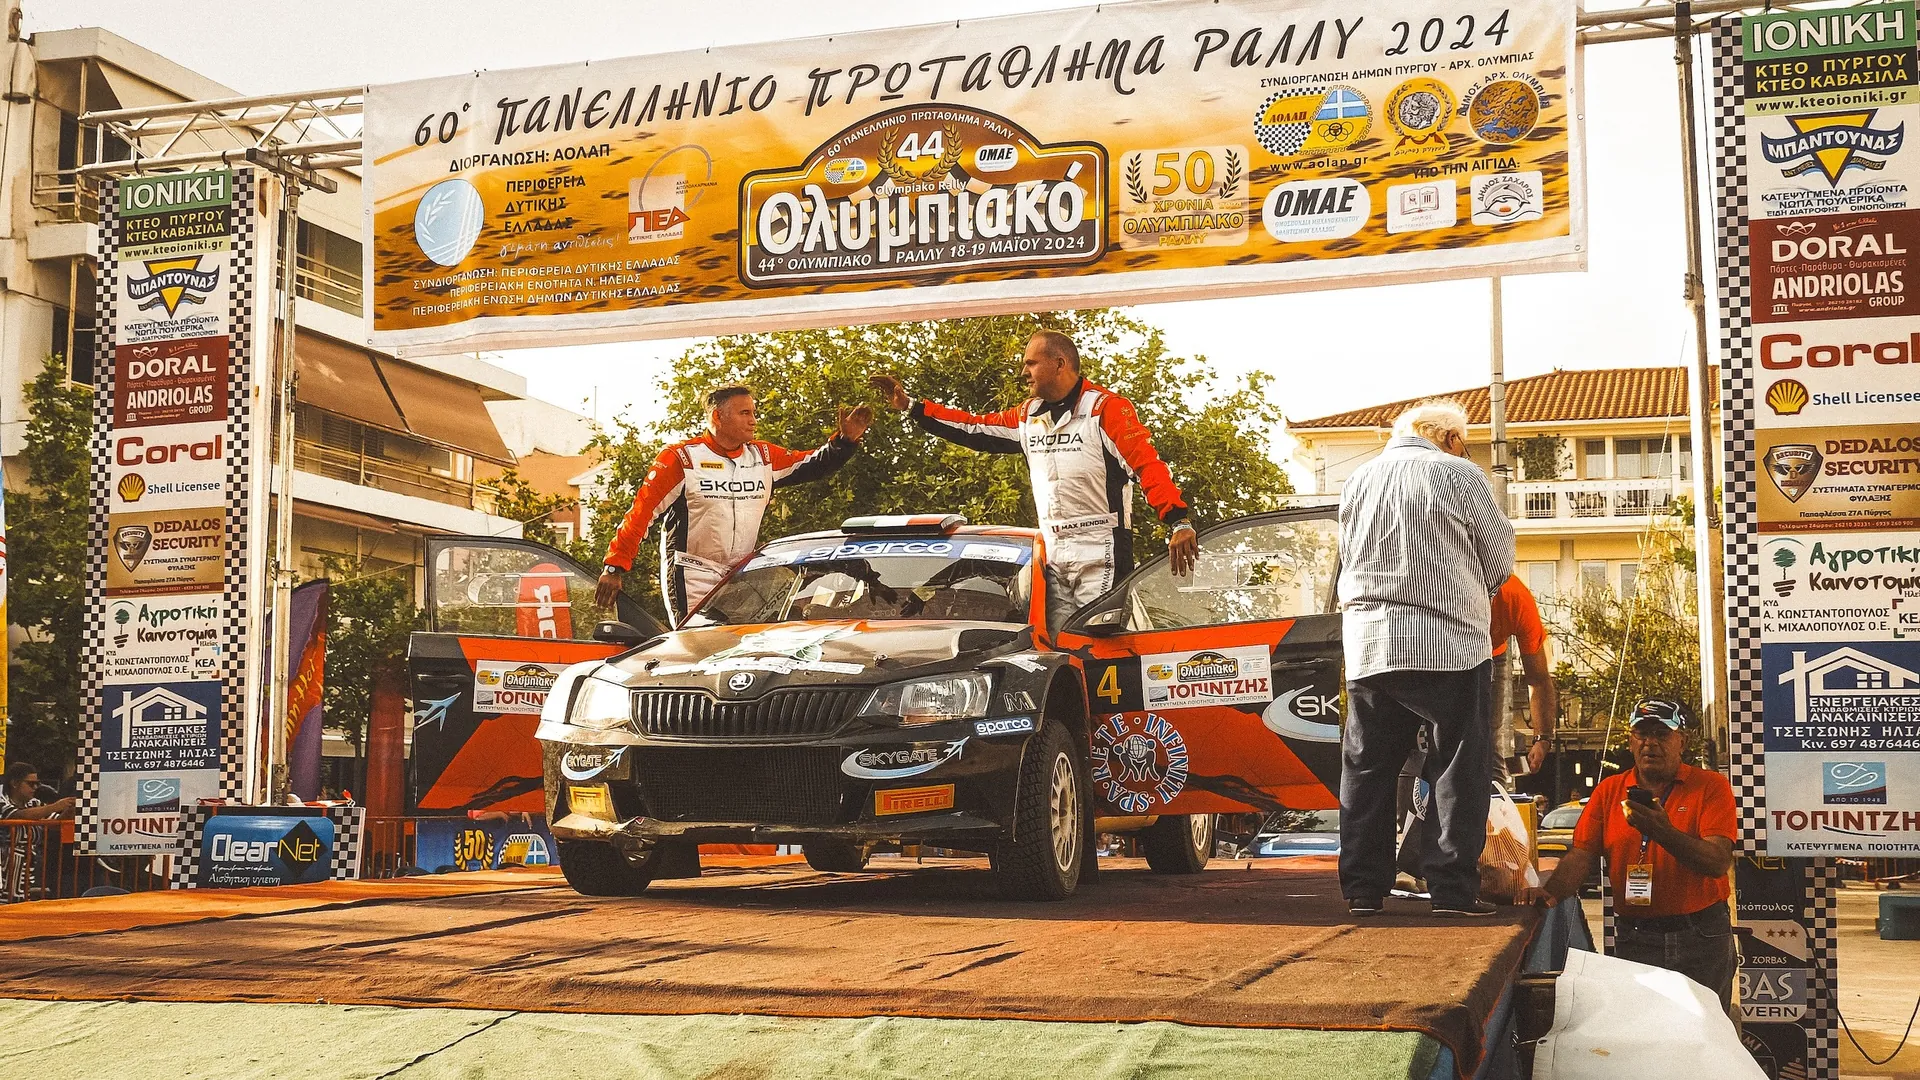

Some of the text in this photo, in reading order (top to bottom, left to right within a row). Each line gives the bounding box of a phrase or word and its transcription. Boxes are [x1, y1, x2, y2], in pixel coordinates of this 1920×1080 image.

[1384, 7, 1514, 55] 2024
[1752, 9, 1905, 52] ΙΟΝΙΚΗ
[1260, 51, 1535, 88] ΣΥΝΔΙΟΡΓΑΝΩΣΗ ΔΗΜΩΝ ΠΥΡΓΟΥ ΑΡΧ. ΟΛΥΜΠΙΑΣ
[1756, 53, 1907, 78] ΚΤΕΟ ΠΥΡΓΟΥ
[1757, 69, 1908, 93] ΚΤΕΟ ΚΑΒΑΣΙΛΑ
[1756, 90, 1907, 112] www.kteoioniki.gr
[843, 114, 907, 146] ΠΑΝΕΛΛΗΝΙΟ
[911, 111, 980, 126] ΠΡΩΤΑΘΛΗΜΑ
[983, 120, 1015, 139] ΡΑΛΛΥ
[896, 130, 944, 162] 44
[1767, 130, 1900, 159] ΜΠΑΝΤΟΥΝΑΣ
[449, 143, 611, 173] ΔΙΟΡΓΑΝΩΣΗ: ΑΟΛΑΠ
[979, 148, 1014, 161] ΟΜΑΕ
[1152, 150, 1215, 196] 50
[1413, 157, 1520, 179] ΥΠΟ ΤΗΝ ΑΙΓΙΔΑ:
[125, 175, 225, 210] ΙΟΝΙΚΗ
[506, 175, 586, 193] ΠΕΡΙΦΕΡΕΙΑ
[876, 178, 967, 198] Olympiako Rally
[1274, 185, 1359, 218] ΟΜΑΕ
[1761, 189, 1844, 201] ΚΑΤΕΨΥΓΜΕΝΑ
[1779, 194, 1885, 209] ΝΩΠΑ ΠΟΥΛΕΡΙΚΑ
[505, 197, 567, 213] ΔΥΤΙΚΗΣ
[1153, 198, 1214, 213] ΧΡΟΝΙΑ
[1789, 206, 1840, 216] ΔΙΑΤΡΟΦΗΣ
[126, 210, 225, 230] ΚΤΕΟ ΠΥΡΓΟΥ
[504, 217, 574, 234] ΕΛΛΑΔΑΣ
[1123, 212, 1244, 234] ΟΛΥΜΠΙΑΚΟ
[126, 222, 225, 243] ΚΤΕΟ ΚΑΒΑΣΙΛΑ
[1159, 233, 1208, 247] ΡΑΛΛΥ
[124, 240, 224, 258] www.kteoioniki.gr
[787, 253, 872, 270] ΟΛΥΜΠΙΑΚΟ
[895, 247, 945, 264] ΡΑΛΛΥ
[949, 242, 986, 258] 18-19
[989, 237, 1041, 254] ΜΑΪΟΥ
[1044, 235, 1085, 251] 2024
[1771, 233, 1907, 263] DORAL
[413, 255, 681, 290] ΣΥΝΔΙΟΡΓΑΝΩΣΗ: ΠΕΡΙΦΕΡΕΙΑ ΔΥΤΙΚΗΣ ΕΛΛΑΔΑΣ
[1770, 258, 1907, 274] Πόρτες Θωρακισμένες
[130, 272, 218, 296] ΜΠΑΝΤΟΥΝΑΣ
[450, 273, 642, 298] ΠΕΡΙΦΕΡΕΙΑΚΗ ΕΝΟΤΗΤΑ ΗΛΕΙΑΣ
[1771, 270, 1904, 300] ANDRIOLAS
[412, 282, 681, 316] ΠΕΡΙΦΕΡΕΙΑΚΗ ΕΝΩΣΗ ΔΗΜΩΝ ΔΥΤΙΚΗΣ ΕΛΛΑΔΑΣ
[1868, 295, 1905, 307] GROUP
[1760, 332, 1920, 370] Coral
[128, 355, 217, 380] DORAL
[126, 385, 214, 410] ANDRIOLAS
[1812, 391, 1920, 406] Shell Licensee
[188, 405, 214, 415] GROUP
[116, 434, 223, 467] Coral
[1825, 437, 1920, 455] DEDALOS
[1776, 451, 1813, 460] SECURITY
[1824, 458, 1920, 476] SECURITY
[147, 481, 221, 495] Shell Licensee
[1812, 485, 1866, 494] ΣΥΣΤΗΜΑΤΑ
[1850, 494, 1892, 502] ΦΥΛΑΞΗΣ
[1864, 508, 1892, 518] Πύργος
[153, 518, 221, 533] DEDALOS
[152, 535, 222, 551] SECURITY
[803, 540, 953, 562] sparco
[138, 599, 218, 628] Αγροτική
[1777, 607, 1890, 619] ΚΩΝΣΤΑΝΤΟΠΟΥΛΟΣ
[137, 622, 217, 644] Καινοτομία
[1778, 621, 1866, 632] ΜΙΧΑΛΟΠΟΥΛΟΣ
[1868, 621, 1891, 631] Ο.Ε.
[114, 655, 190, 666] ΚΩΝΣΤΑΝΤΟΠΟΥΛΟΣ
[195, 659, 216, 667] ΚΕΑ
[114, 666, 173, 676] ΜΙΧΑΛΟΠΟΥΛΟΣ
[1180, 662, 1235, 678] Ολυμπιακό
[1096, 665, 1122, 705] 4
[1168, 678, 1268, 699] ΤΟΠΙΝΤΖΗΣ
[1809, 697, 1920, 707] ΕΝΕΡΓΕΙΑΚΕΣ
[1810, 712, 1920, 722] ΑΝΑΚΑΙΝΙΣΕΙΣ
[132, 726, 207, 736] ΕΝΕΡΓΕΙΑΚΕΣ
[976, 719, 1032, 735] sparco
[1773, 726, 1871, 737] ΤΣΕΤΣΩΝΗΣ
[131, 738, 207, 748] ΑΝΑΚΑΙΝΙΣΕΙΣ
[1801, 739, 1920, 749] Κιν. 697 4876446
[106, 748, 217, 760] ΤΣΕΤΣΩΝΗΣ ΗΛΙΑΣ
[859, 749, 938, 767] SKYGATE
[124, 759, 205, 769] Κιν. 697 4876446
[883, 788, 950, 811] PIRELLI
[211, 833, 320, 862] ClearNet
[463, 829, 486, 861] 50
[1787, 843, 1863, 851] ΚΑΤΕΨΥΓΜΕΝΑ
[1752, 956, 1787, 964] ZORBAS
